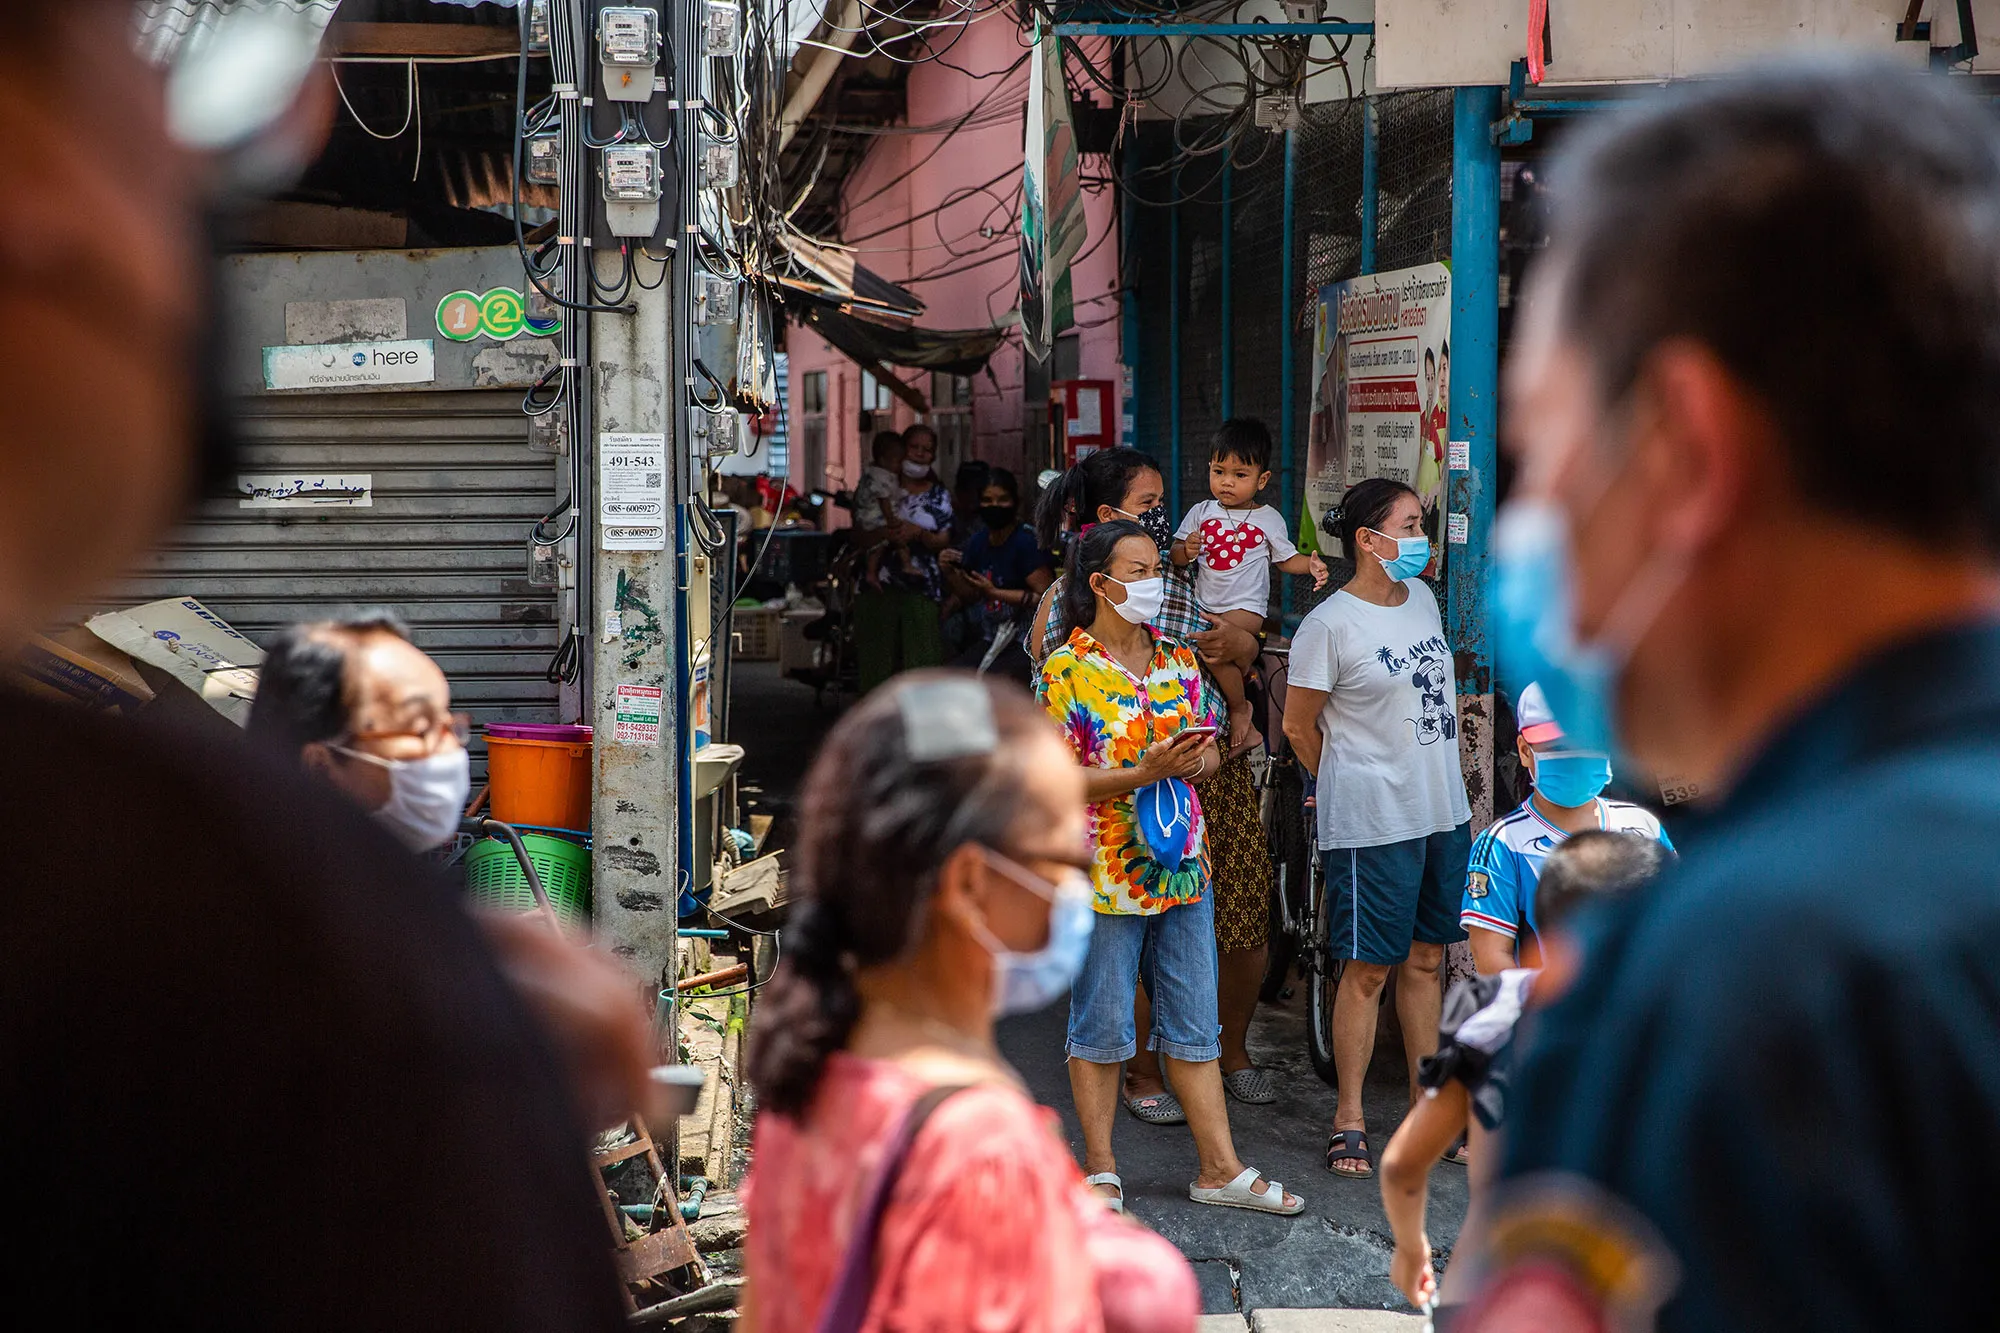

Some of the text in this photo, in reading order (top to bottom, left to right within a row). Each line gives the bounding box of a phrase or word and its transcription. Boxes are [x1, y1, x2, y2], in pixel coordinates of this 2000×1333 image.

[373, 348, 419, 366] here
[609, 456, 655, 467] 491-543
[1663, 783, 1699, 802] 539
